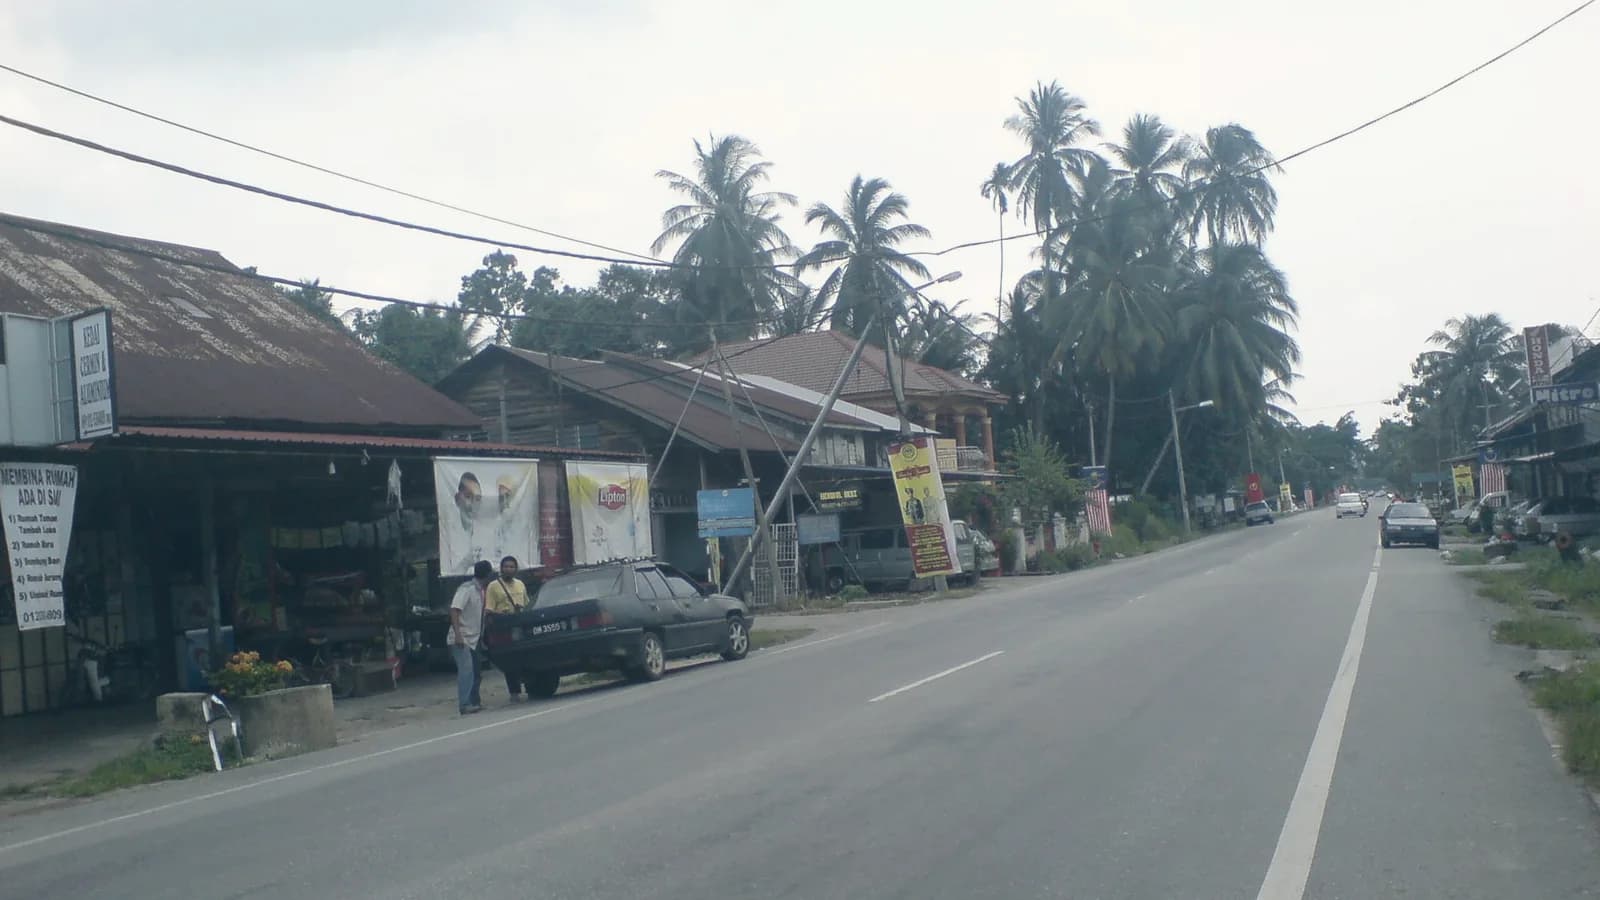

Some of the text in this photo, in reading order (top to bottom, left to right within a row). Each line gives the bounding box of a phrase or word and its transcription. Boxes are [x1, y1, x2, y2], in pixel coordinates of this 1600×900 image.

[1531, 337, 1545, 375] HONDA
[1, 467, 75, 488] MEMBINA RUMAH
[18, 488, 36, 506] ADA
[37, 488, 46, 505] DI
[600, 491, 626, 506] Lipton
